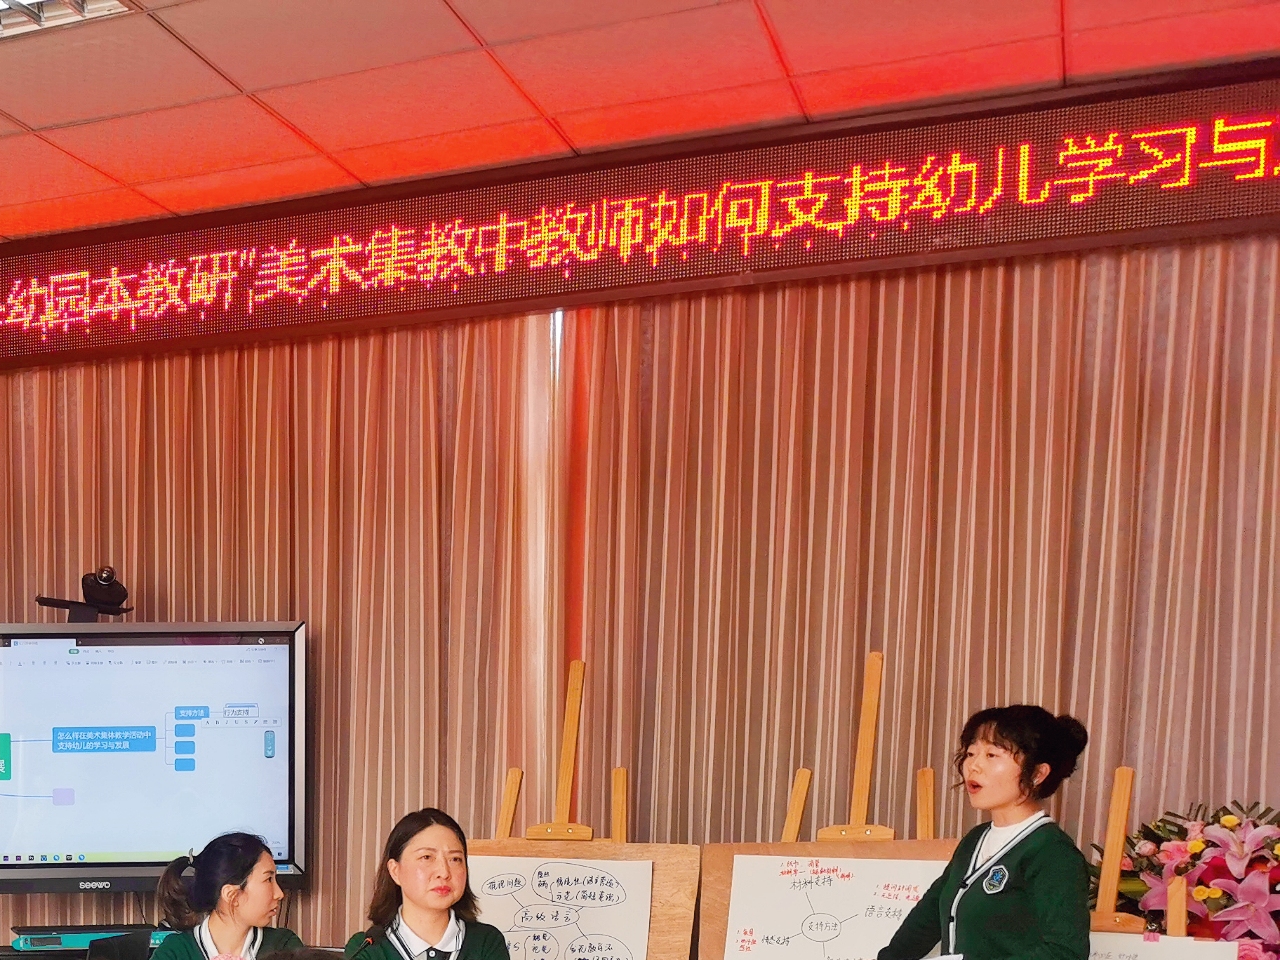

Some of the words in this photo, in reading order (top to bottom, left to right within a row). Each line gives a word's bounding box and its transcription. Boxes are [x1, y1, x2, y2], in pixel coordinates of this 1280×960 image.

[179, 709, 205, 717] 支持方法
[57, 730, 152, 741] 怎么样在美术集体教学活动中
[57, 741, 130, 750] 支持幼儿的学习与发展
[79, 881, 111, 889] seewo
[789, 875, 834, 891] 材料支持
[807, 921, 838, 932] 支持方法
